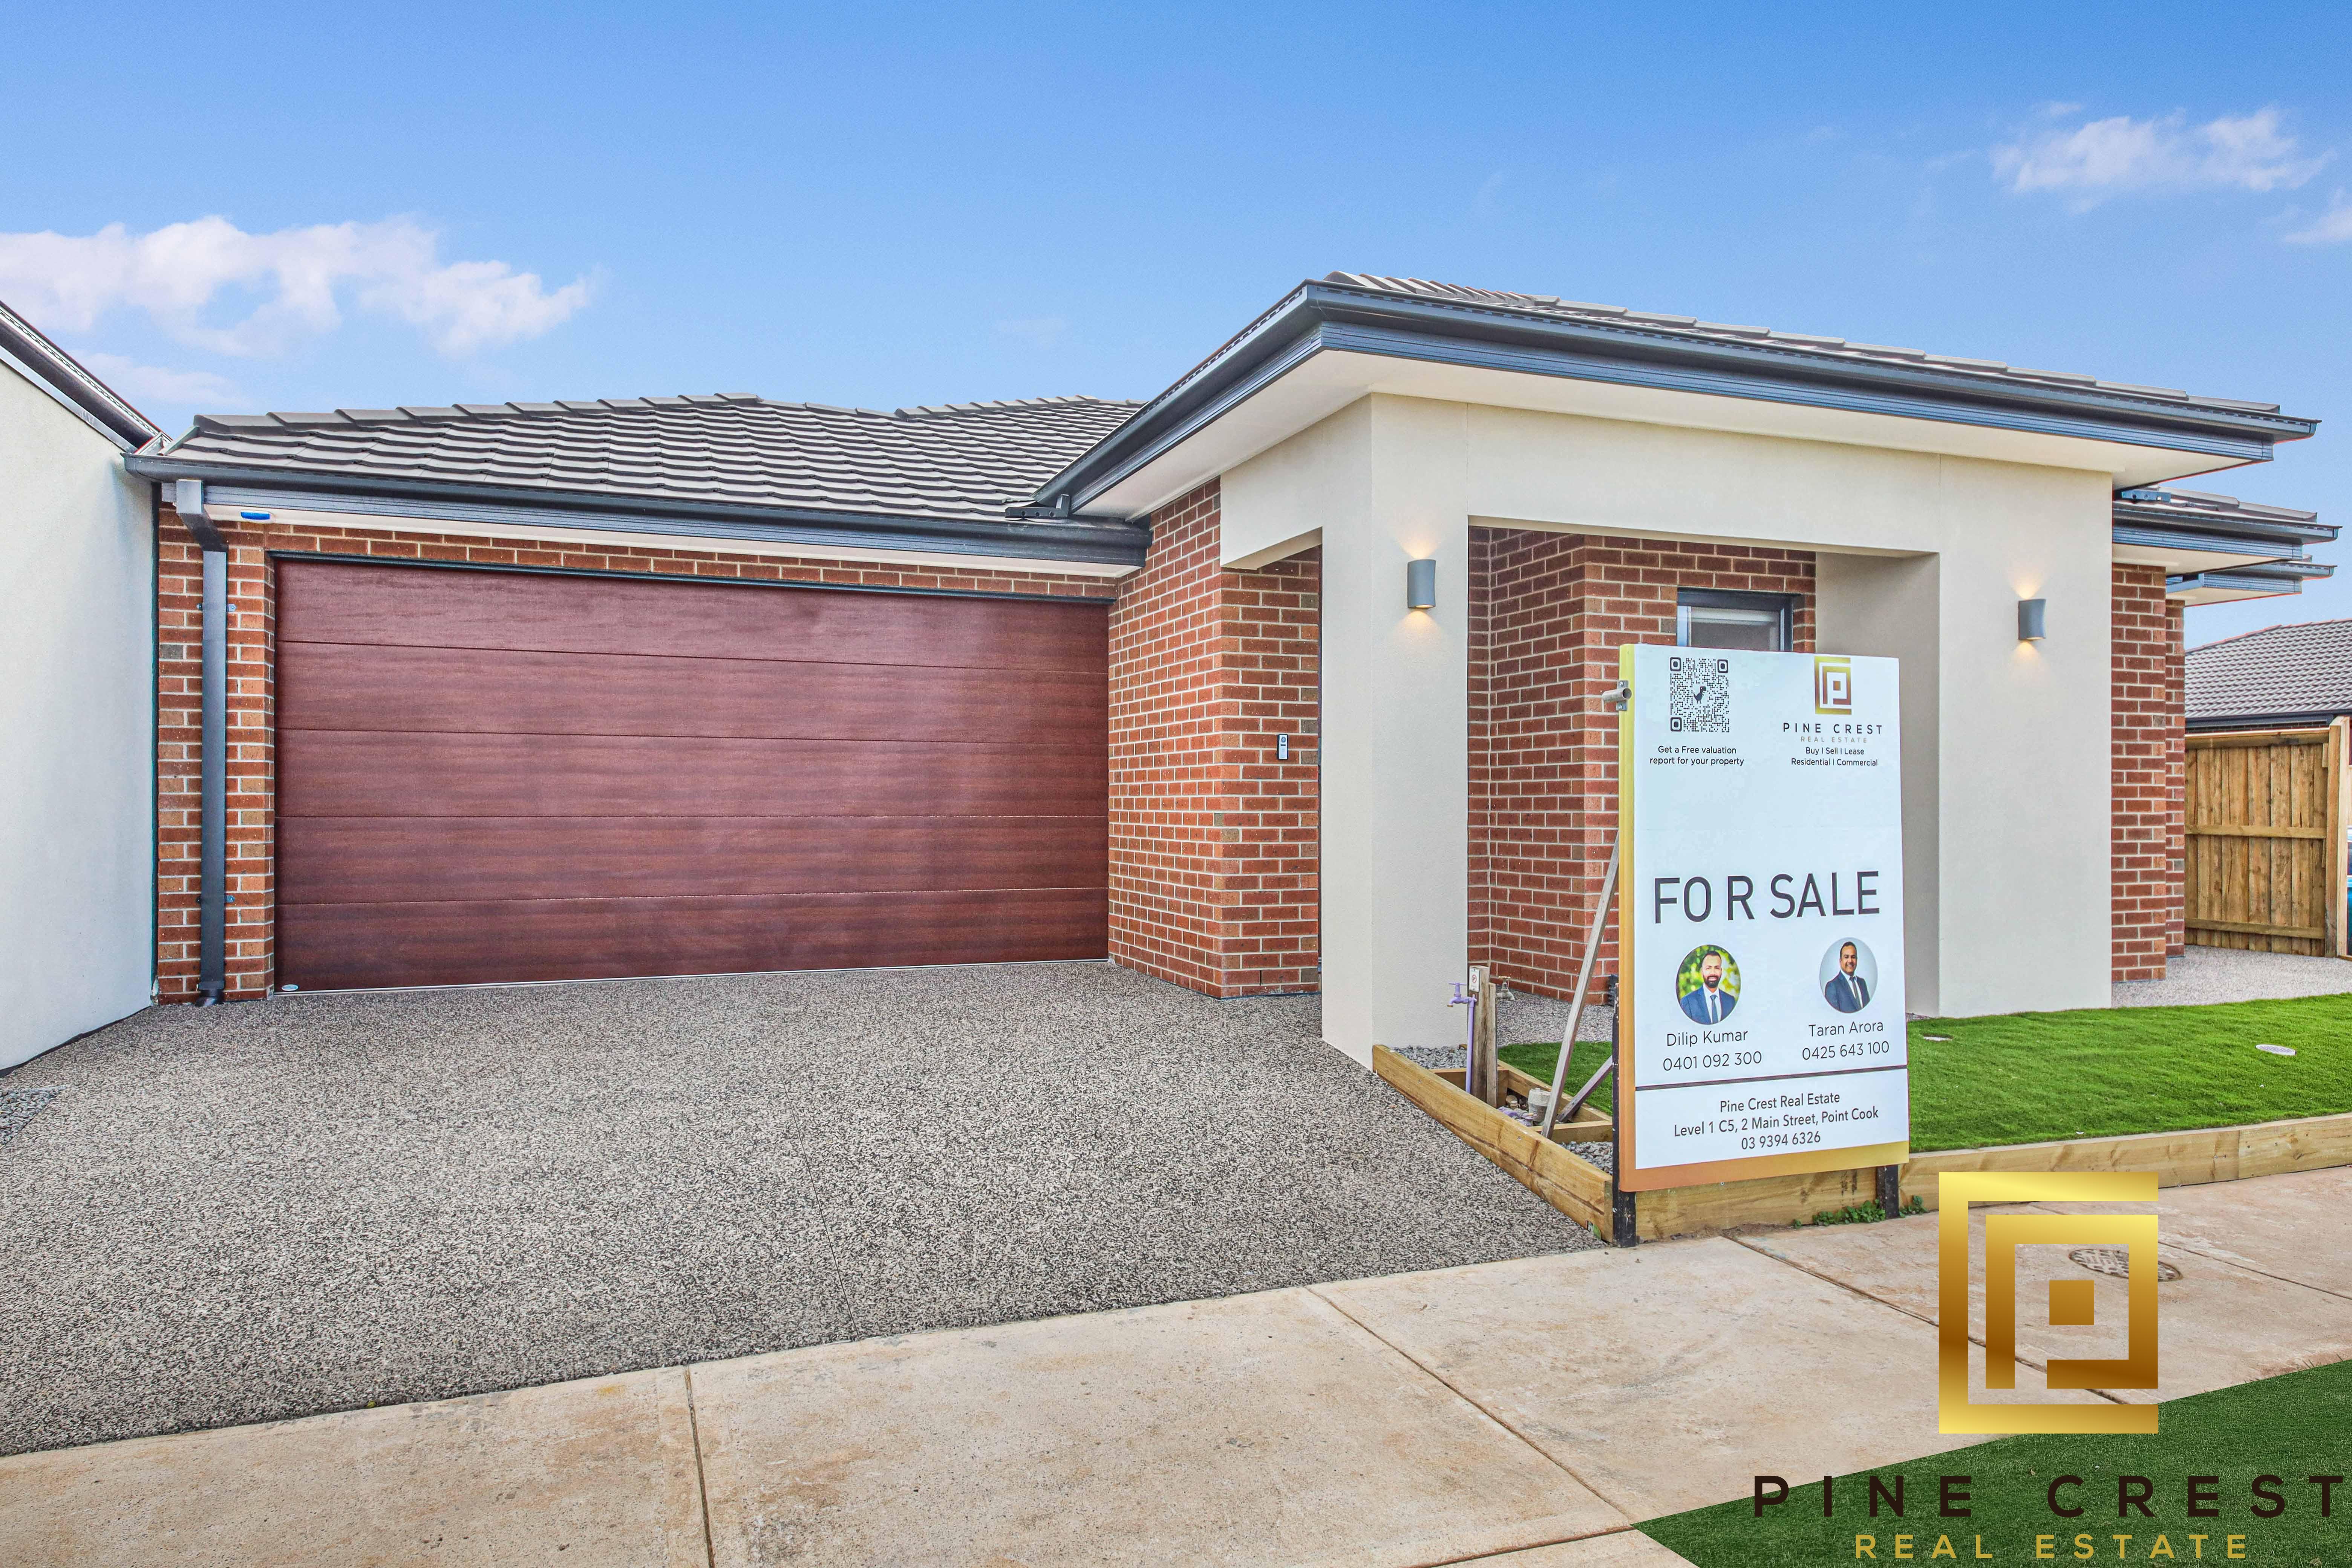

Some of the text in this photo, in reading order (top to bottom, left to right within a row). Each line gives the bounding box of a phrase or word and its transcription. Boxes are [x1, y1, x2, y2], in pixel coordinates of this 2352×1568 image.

[1783, 723, 1882, 734] PINE CREST
[1805, 747, 1819, 755] Buy
[1650, 757, 1675, 765] report
[1711, 758, 1744, 766] property
[1655, 871, 1880, 923] FOR SALE
[1808, 1021, 1883, 1037] Taran Arora
[1667, 1031, 1748, 1047] Dilip Kumar
[1802, 1041, 1889, 1060] 0425 643 100
[1663, 1051, 1762, 1071] 0401 092 300
[1720, 1093, 1840, 1113] Pine Crest Real Estate
[1675, 1106, 1879, 1136] Level 1 C5, 2 Main Street, Point Cook
[1741, 1131, 1821, 1150] 03 9394 6326
